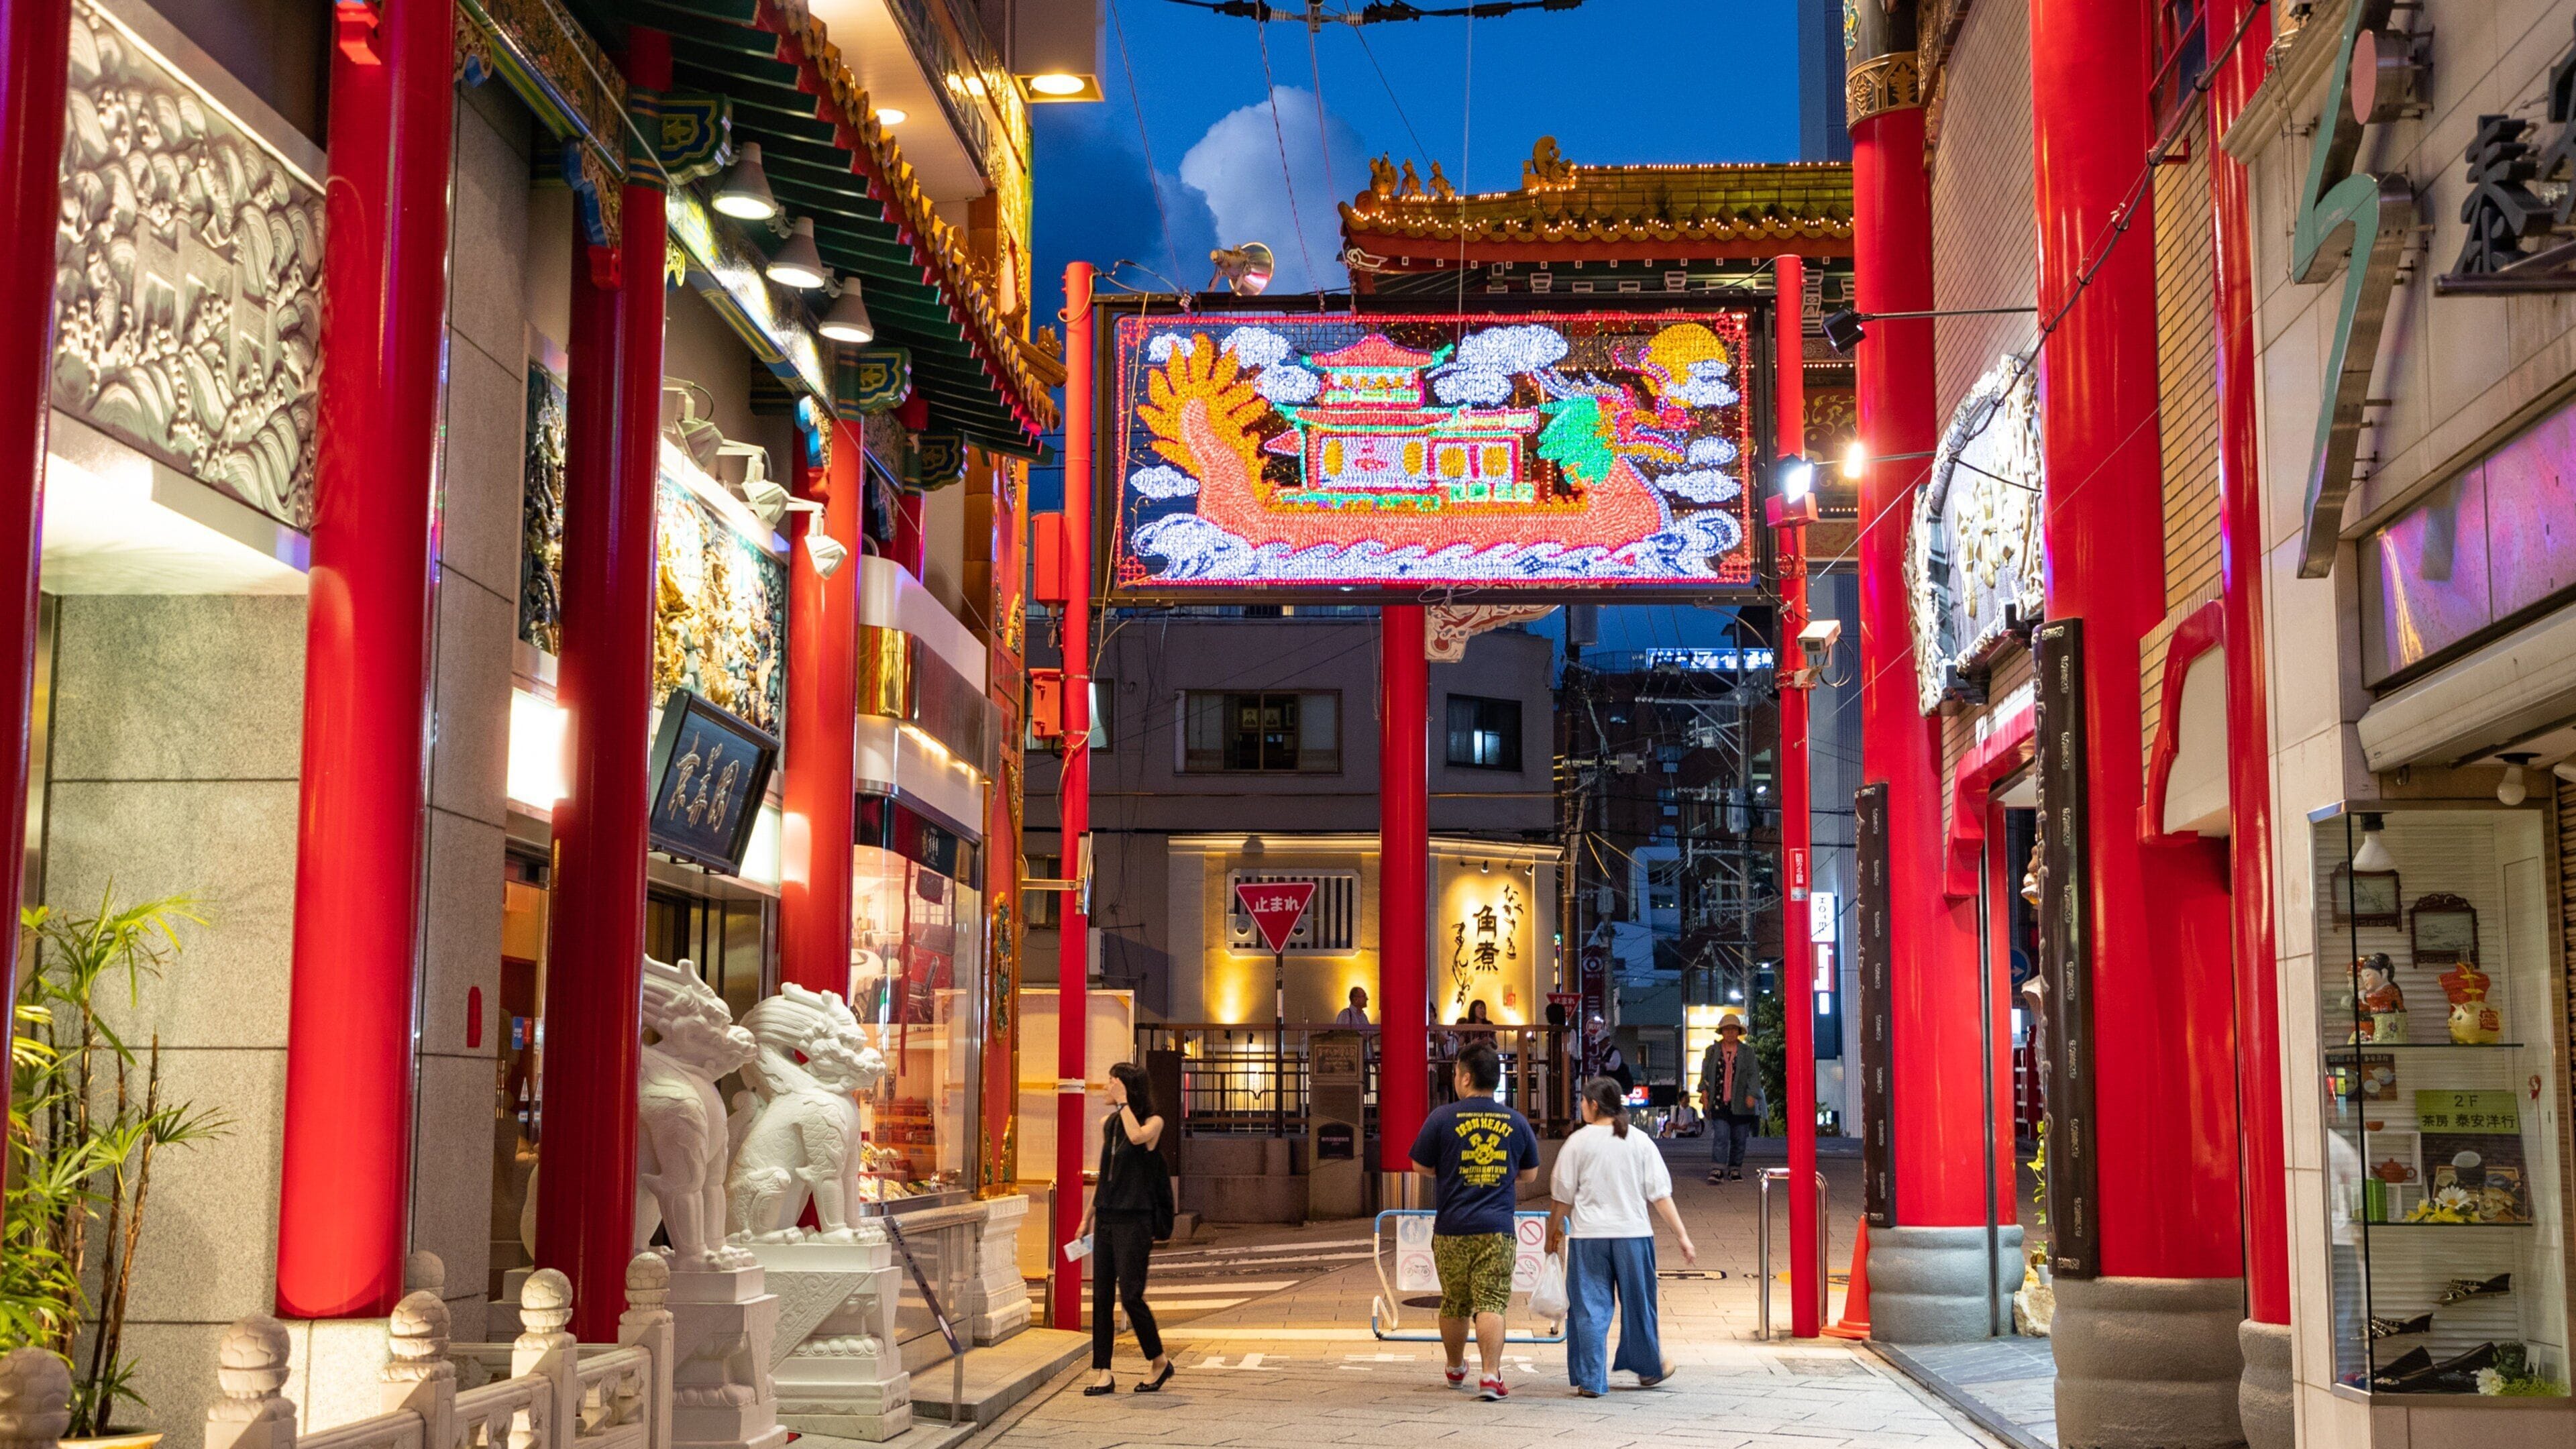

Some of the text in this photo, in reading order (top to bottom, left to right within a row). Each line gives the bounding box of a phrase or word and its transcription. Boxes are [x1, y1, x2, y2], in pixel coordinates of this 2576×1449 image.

[1253, 896, 1300, 913] 止まれ
[1472, 904, 1500, 971] 角煮
[2455, 1094, 2479, 1108] 2F
[1455, 1118, 1513, 1138] IRON HEART
[2421, 1113, 2516, 1128] 茶房 泰安洋行
